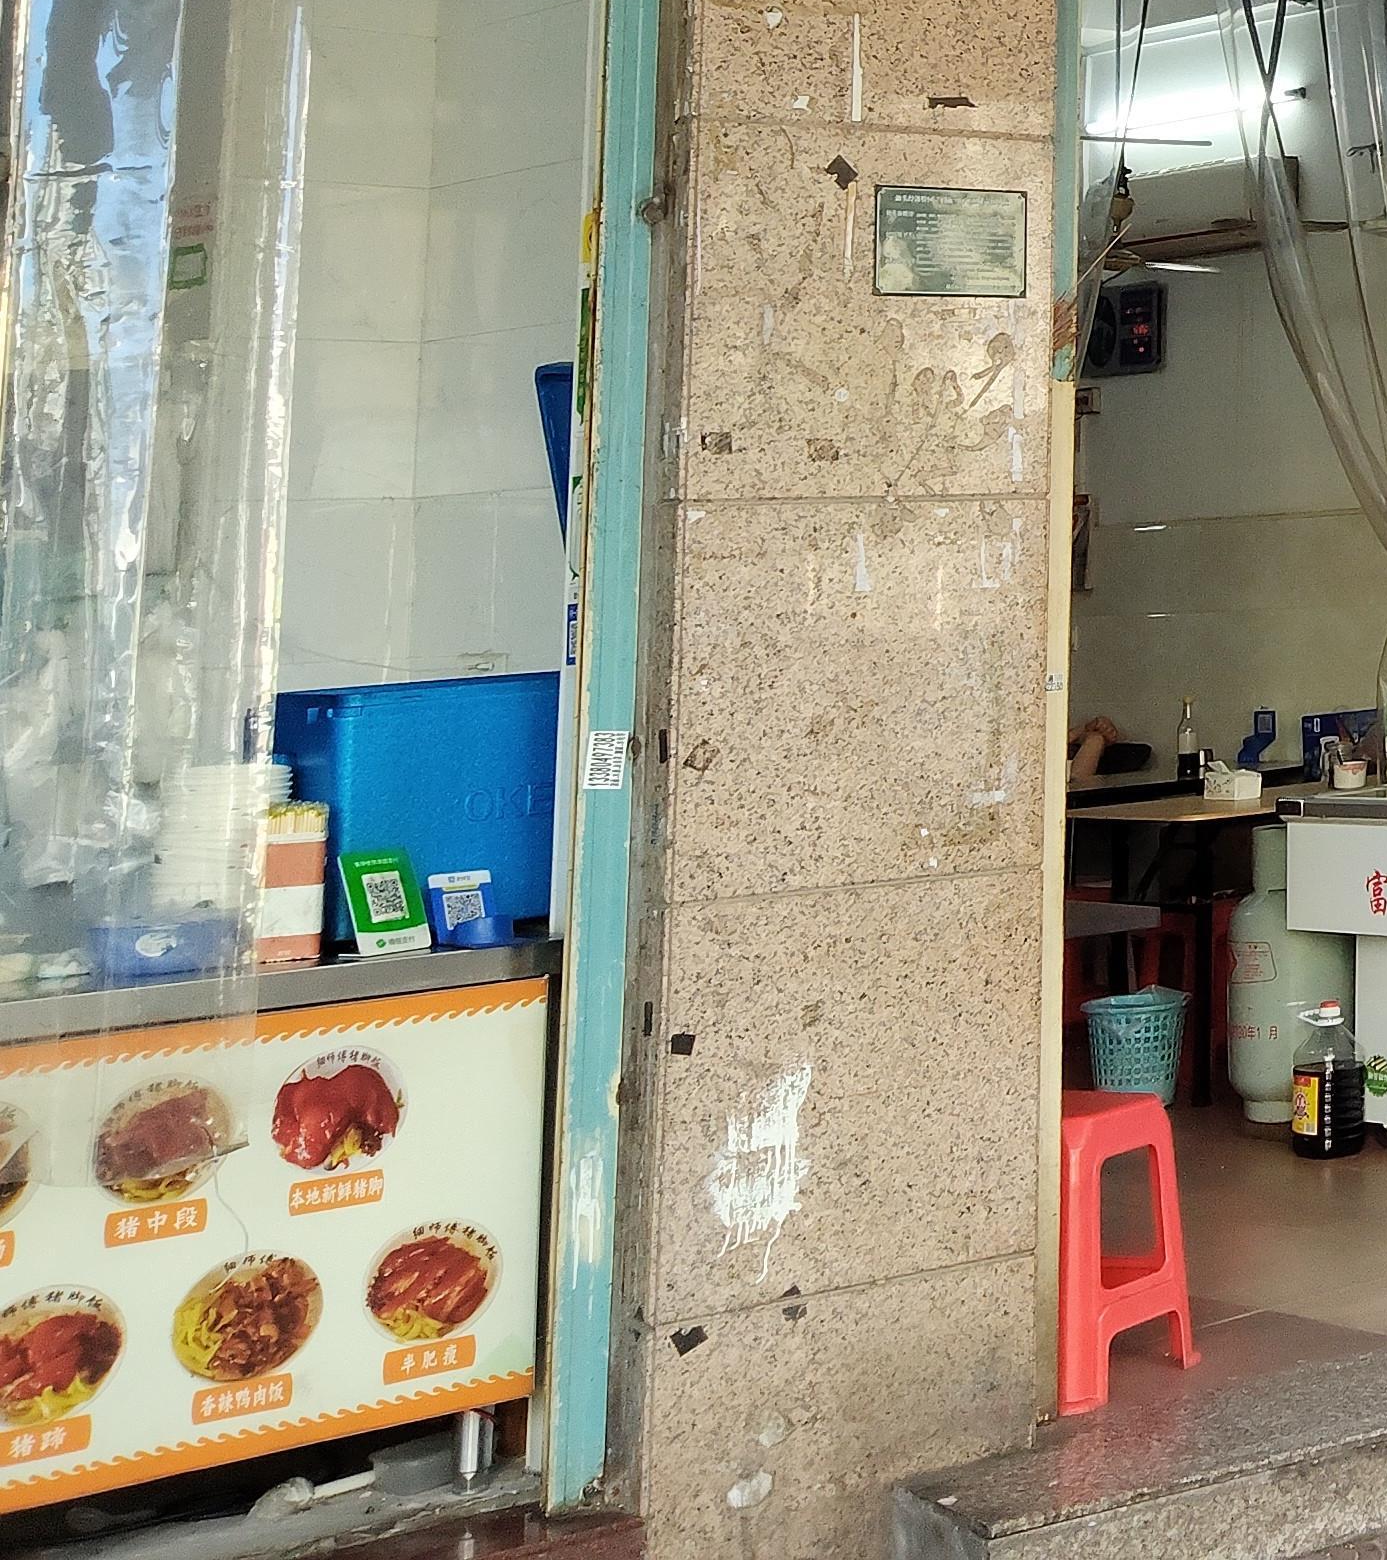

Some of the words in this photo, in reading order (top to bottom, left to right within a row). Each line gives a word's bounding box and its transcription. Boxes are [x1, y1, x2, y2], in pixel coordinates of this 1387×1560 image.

[290, 1175, 383, 1209] 本地新鲜猪脚
[114, 1206, 199, 1240] 猪中段
[200, 1381, 285, 1416] 香辣鸭肉饭
[7, 1426, 67, 1457] 猪蹄
